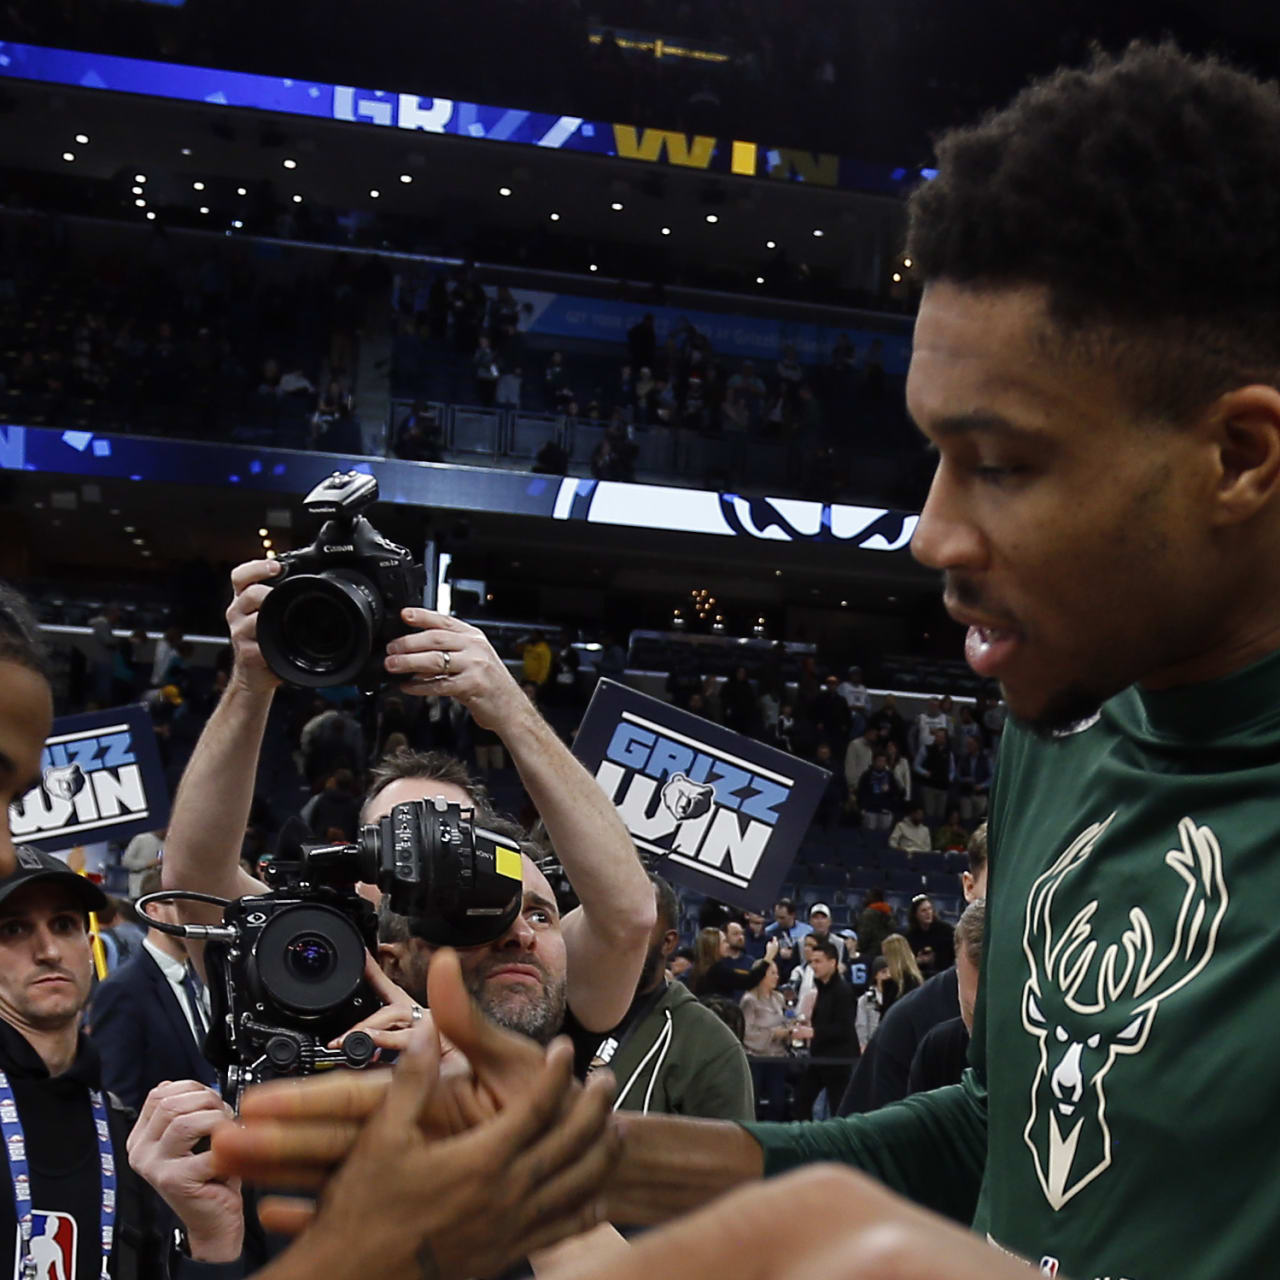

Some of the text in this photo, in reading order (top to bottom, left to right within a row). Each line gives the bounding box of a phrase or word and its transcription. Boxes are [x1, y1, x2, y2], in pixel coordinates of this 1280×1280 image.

[323, 545, 354, 553] Canon
[40, 732, 136, 773] IZZ
[606, 721, 790, 824] GRIZZ
[8, 764, 147, 835] WIN
[594, 759, 773, 879] WIN
[8, 1142, 26, 1161] NBA
